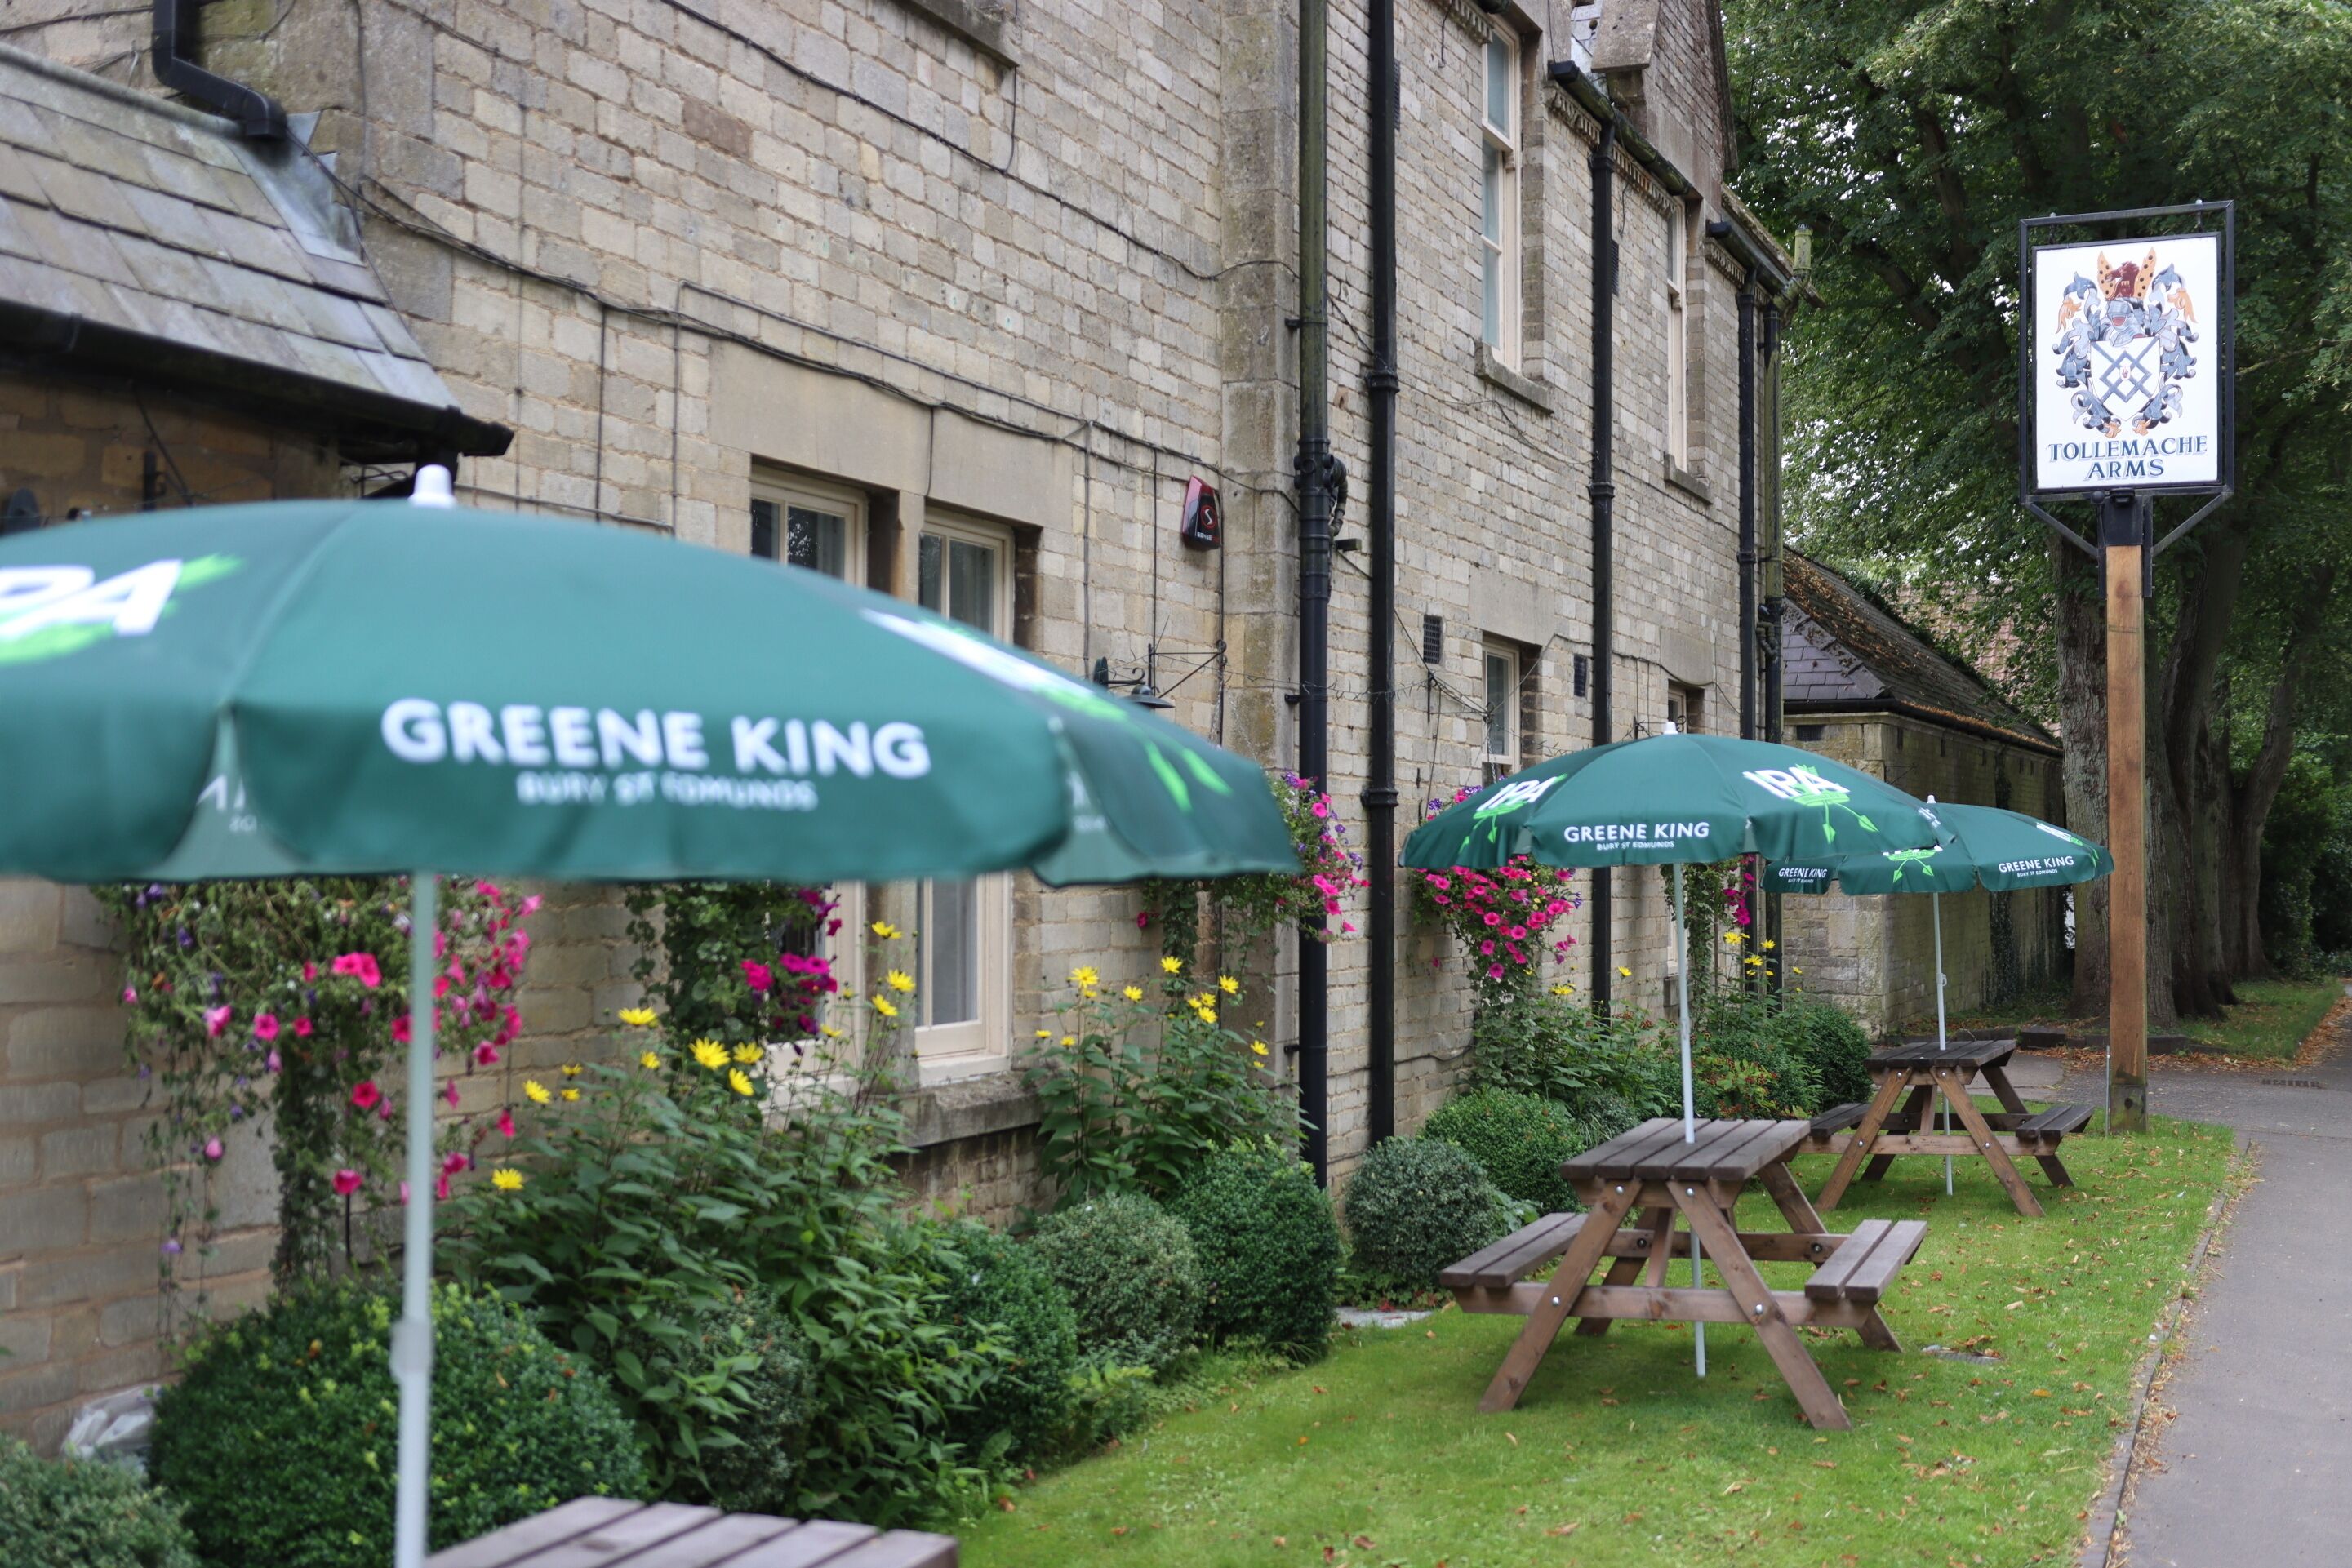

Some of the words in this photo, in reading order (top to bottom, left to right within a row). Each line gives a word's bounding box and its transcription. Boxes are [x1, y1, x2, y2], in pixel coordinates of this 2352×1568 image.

[2047, 435, 2208, 462] TOLLEMACHE
[2085, 458, 2165, 480] ARMS
[381, 698, 709, 770] GREENE
[731, 715, 931, 779] KING
[1476, 776, 1558, 811] IPA
[1741, 767, 1851, 799] IPA
[1564, 824, 1647, 842] GREENE
[1654, 822, 1710, 838] KING
[1596, 842, 1619, 851] BURY
[1633, 841, 1674, 849] EDMUNDS
[1778, 868, 1809, 878] GREENE
[1809, 868, 1828, 878] KING
[1998, 859, 2042, 873] GREENE
[2043, 855, 2074, 868] KING
